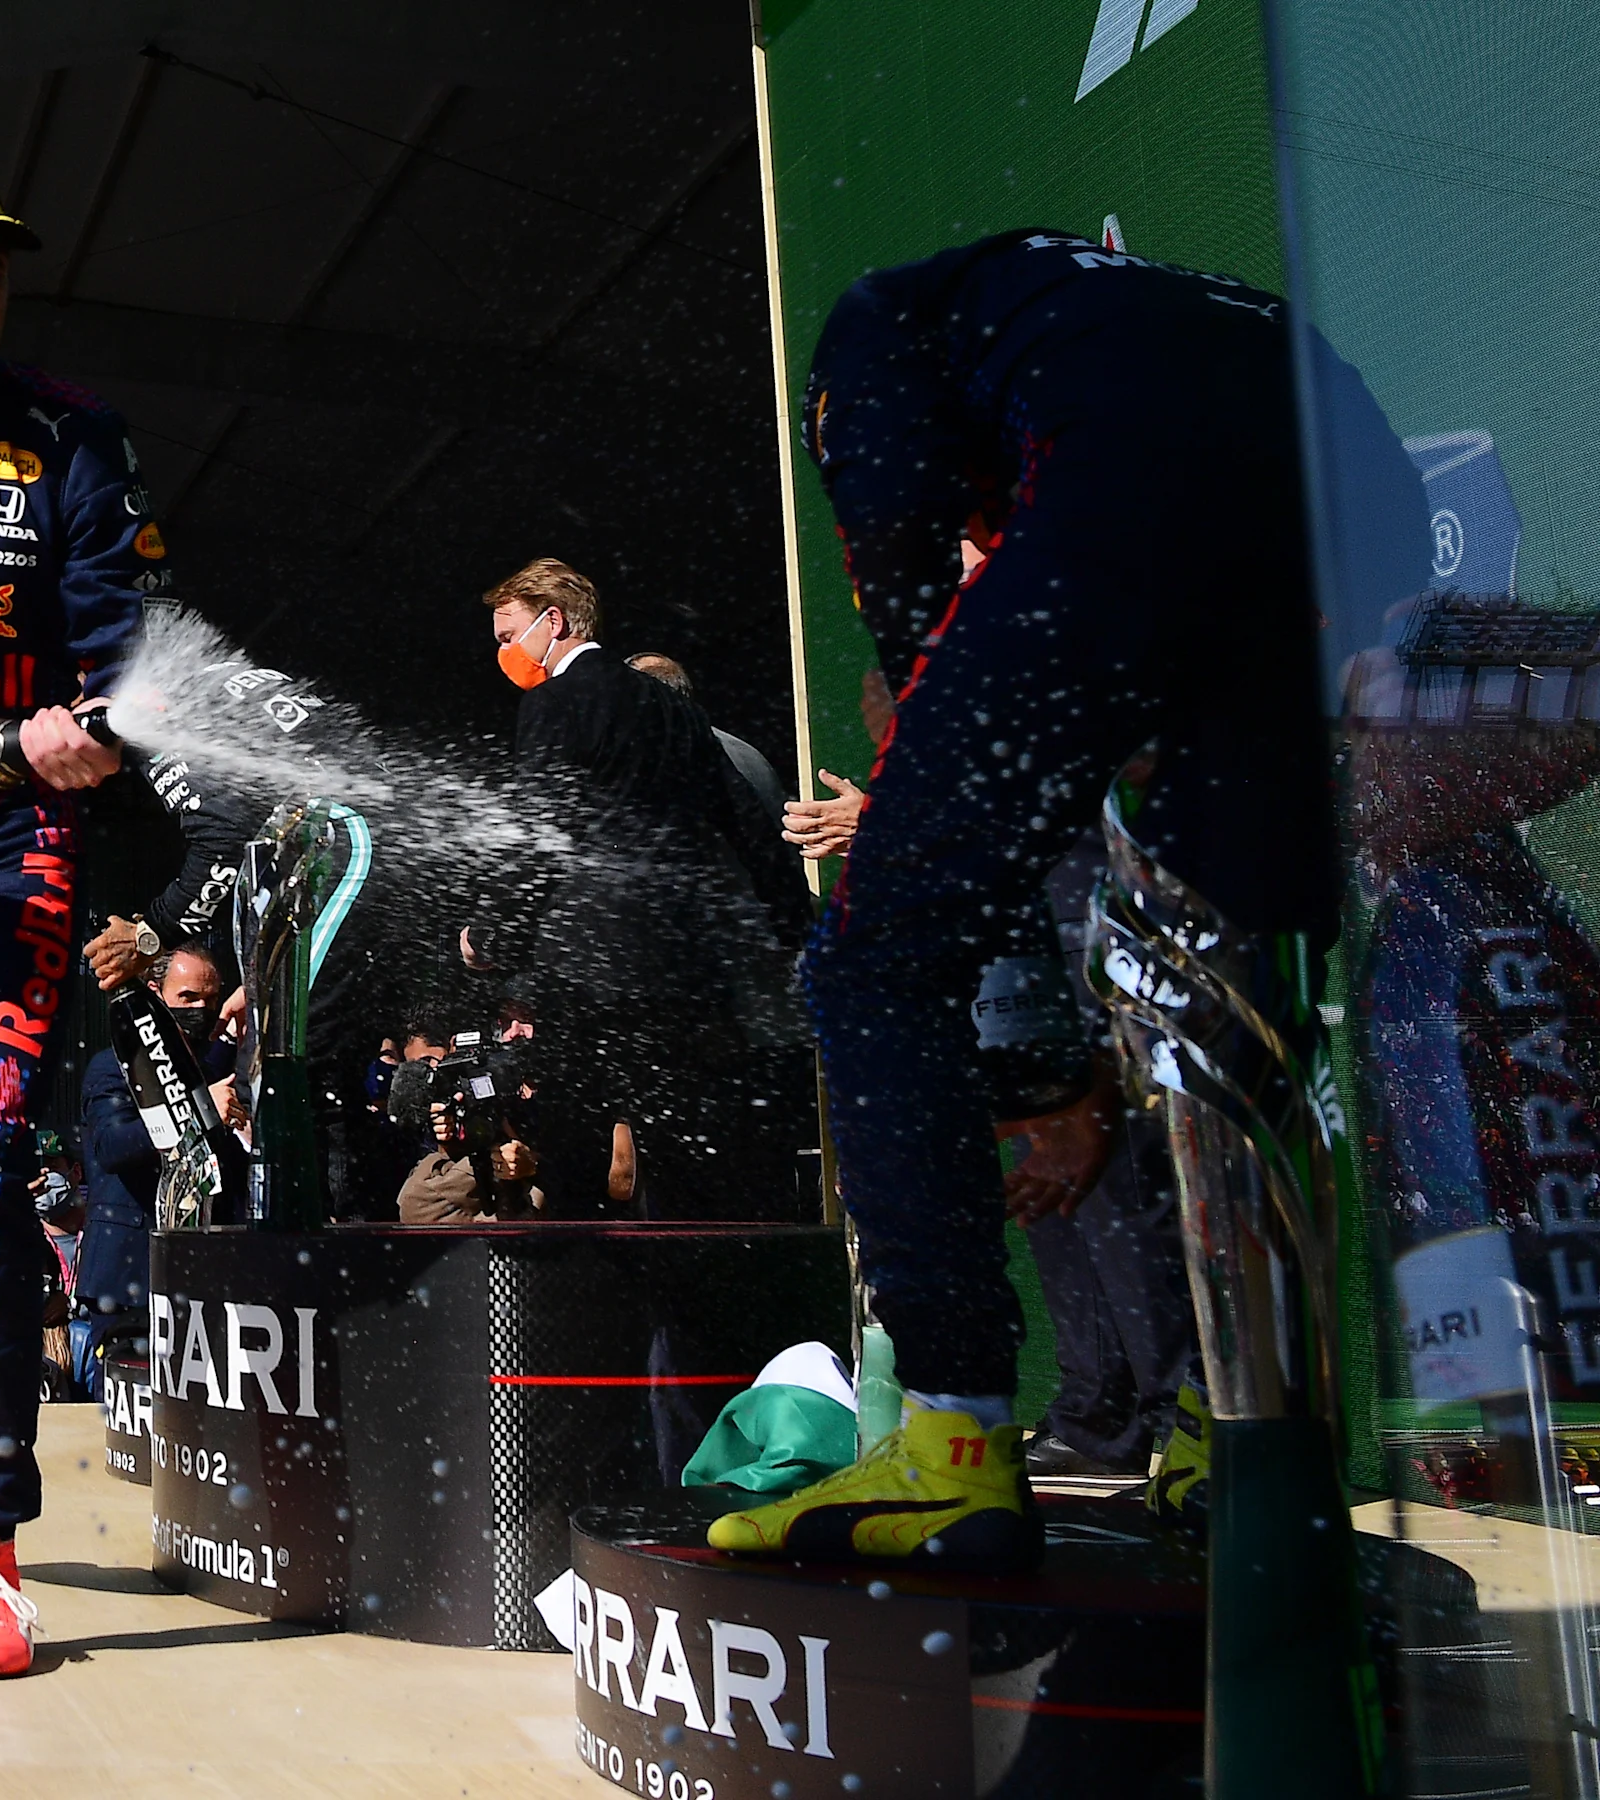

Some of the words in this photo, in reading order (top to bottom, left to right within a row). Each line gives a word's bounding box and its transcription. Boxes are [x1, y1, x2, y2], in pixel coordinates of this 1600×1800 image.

[153, 761, 190, 796] EPSON
[164, 781, 191, 809] IWC
[174, 1443, 228, 1487] 1902
[948, 1436, 987, 1467] 11
[172, 1521, 255, 1584] Formula
